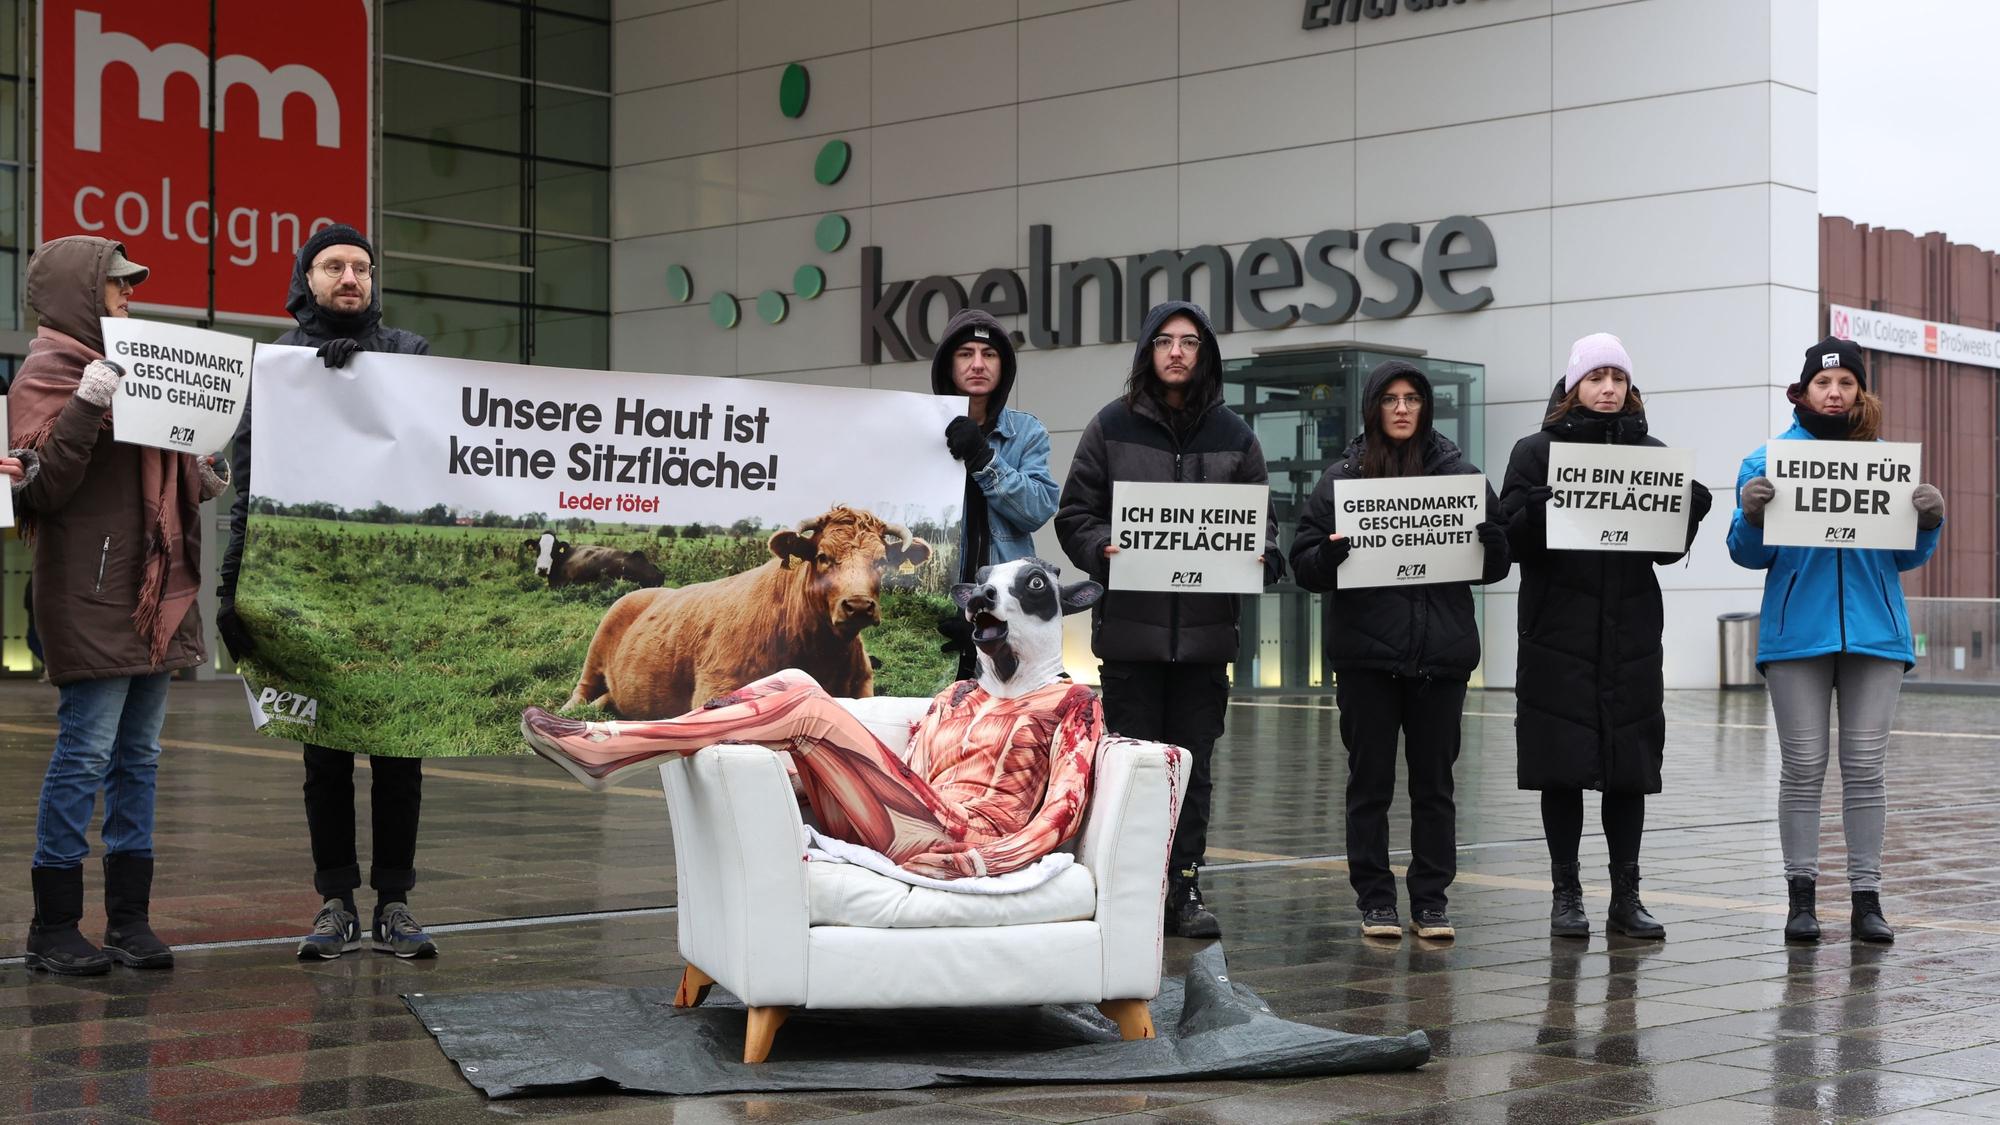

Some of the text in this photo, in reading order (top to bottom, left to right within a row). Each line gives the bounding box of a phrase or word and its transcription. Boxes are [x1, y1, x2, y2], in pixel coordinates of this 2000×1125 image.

[860, 214, 1498, 365] koelnmesse
[1852, 315, 1871, 338] ISM
[1874, 320, 1918, 348] Cologne
[1941, 330, 1991, 358] ProSweets
[115, 340, 245, 378] GEBRANDMARKT,
[133, 362, 232, 394] GESCHLAGEN
[125, 381, 236, 415] UND GEHÄUTET
[462, 386, 769, 444] Unsere Haut ist
[449, 435, 778, 491] keine Sitzfläche!
[1776, 458, 1911, 483] LEIDEN FÜR
[1556, 467, 1684, 487] ICH BIN KEINE
[559, 491, 660, 513] Leder tötet
[1343, 495, 1478, 513] GEBRANDMARKT,
[1553, 487, 1682, 513] SITZFLÄCHE
[1795, 486, 1891, 515] LEDER
[1121, 506, 1257, 525] ICH BIN KEINE
[1359, 513, 1463, 530] GESCHLAGEN
[1119, 526, 1256, 552] SITZFLÄCHE
[1350, 529, 1473, 549] UND GEHÄUTET
